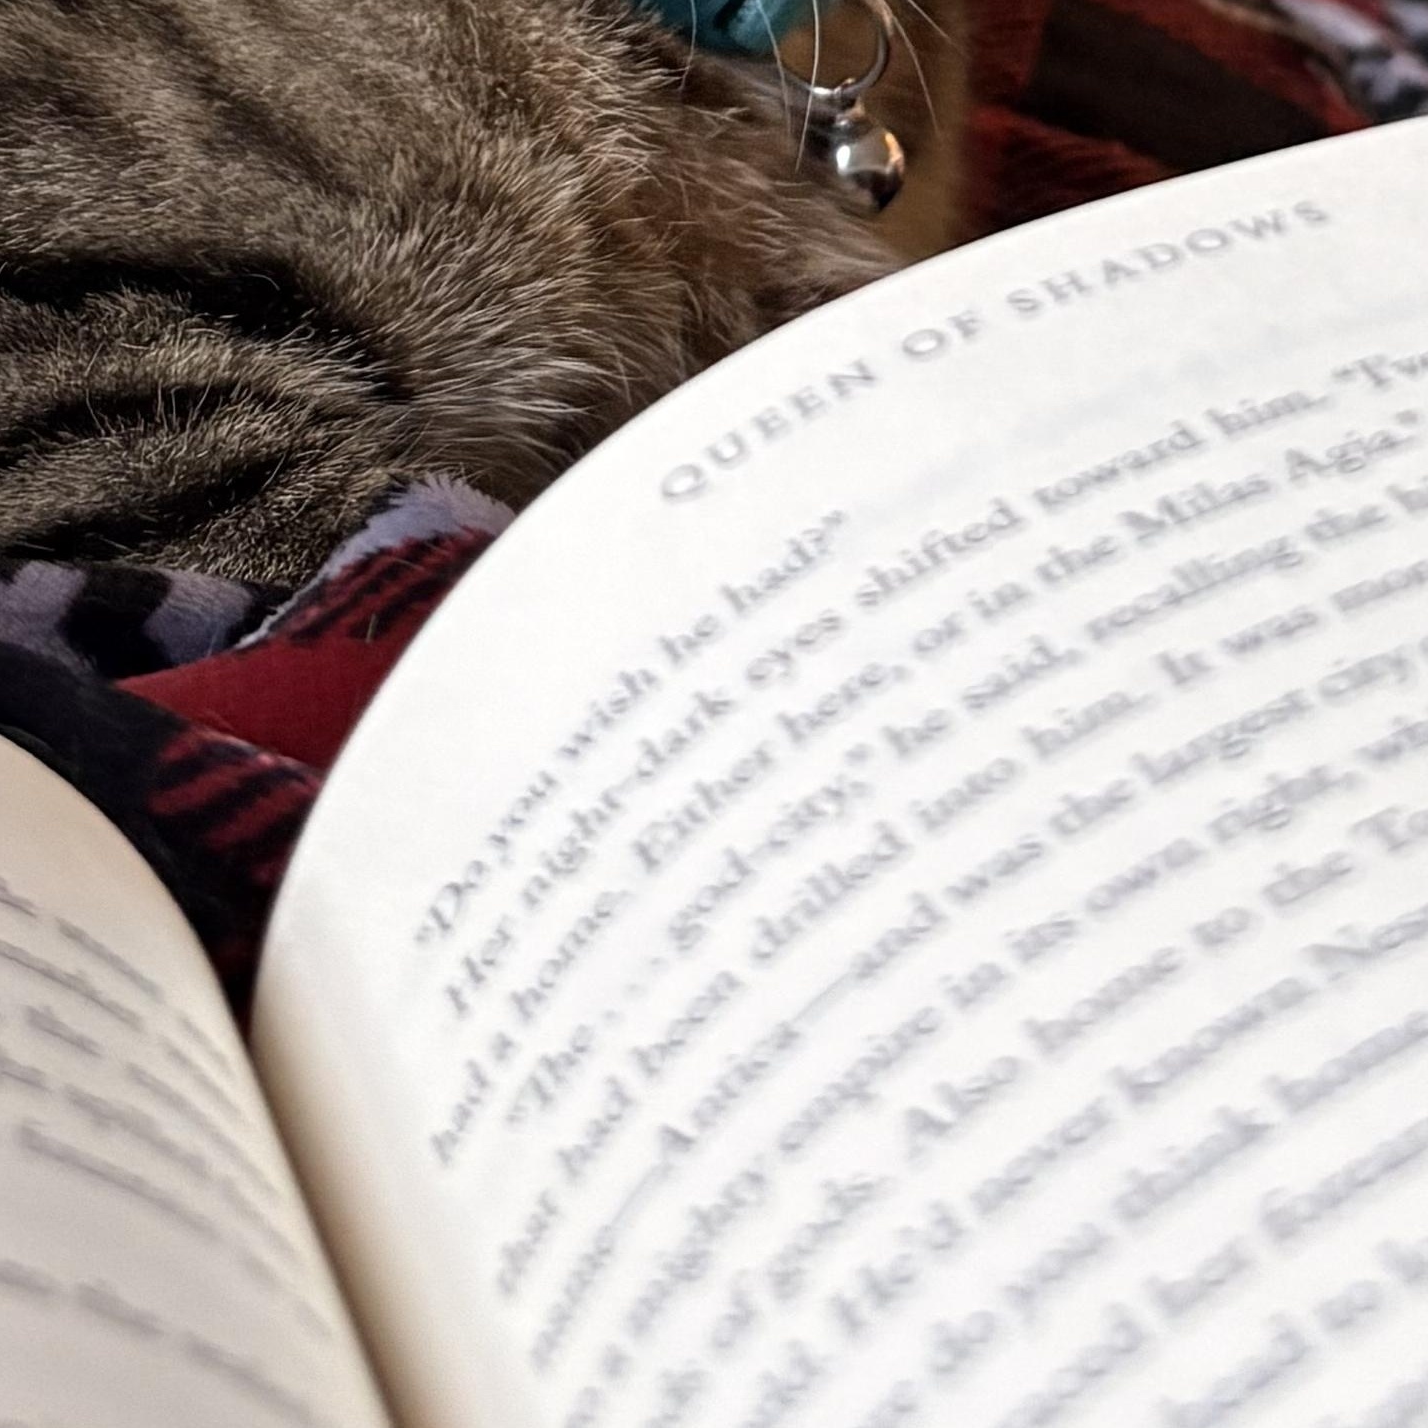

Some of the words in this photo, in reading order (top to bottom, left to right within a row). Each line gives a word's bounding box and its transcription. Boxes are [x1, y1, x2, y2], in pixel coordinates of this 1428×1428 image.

[660, 360, 878, 503] QUEEN
[900, 310, 982, 362] OF
[1006, 203, 1330, 318] SHADOWS
[444, 915, 514, 1020] Her
[520, 691, 738, 912] night-dark
[745, 615, 845, 689] eyes
[855, 498, 1026, 609] shifted
[1032, 421, 1207, 514] toward
[1205, 392, 1334, 440] him.
[486, 771, 560, 867] you
[556, 669, 661, 762] wish
[657, 615, 720, 668] he
[881, 710, 952, 761] he
[960, 635, 1085, 713] said,
[1084, 537, 1308, 645] recalling
[1303, 506, 1390, 547] the
[944, 841, 1048, 905] was
[1047, 781, 1136, 840] the
[1130, 690, 1314, 788] largest
[1318, 647, 1414, 705] city
[431, 1059, 492, 1167] had
[490, 1032, 517, 1064] a
[630, 742, 775, 876] Either
[775, 664, 911, 748] here,
[911, 613, 966, 659] or
[967, 583, 1034, 623] in
[1035, 536, 1122, 587] the
[1118, 475, 1277, 546] Milas
[555, 1076, 638, 1185] had
[629, 971, 745, 1080] been
[750, 821, 912, 966] drilled
[911, 758, 1023, 834] into
[1020, 692, 1154, 762] him.
[1155, 652, 1214, 690] It
[1219, 607, 1323, 658] was
[626, 1154, 770, 1340] mighty
[777, 1007, 941, 1159] empire
[941, 963, 1011, 1011] in
[1005, 919, 1080, 965] its
[1084, 839, 1208, 917] own
[905, 1057, 1024, 1161] Also
[1023, 948, 1183, 1057] home
[1191, 908, 1254, 951] to
[1261, 852, 1356, 913] the
[969, 1097, 1114, 1218] never
[1110, 977, 1319, 1105] known
[1112, 1105, 1276, 1226] think
